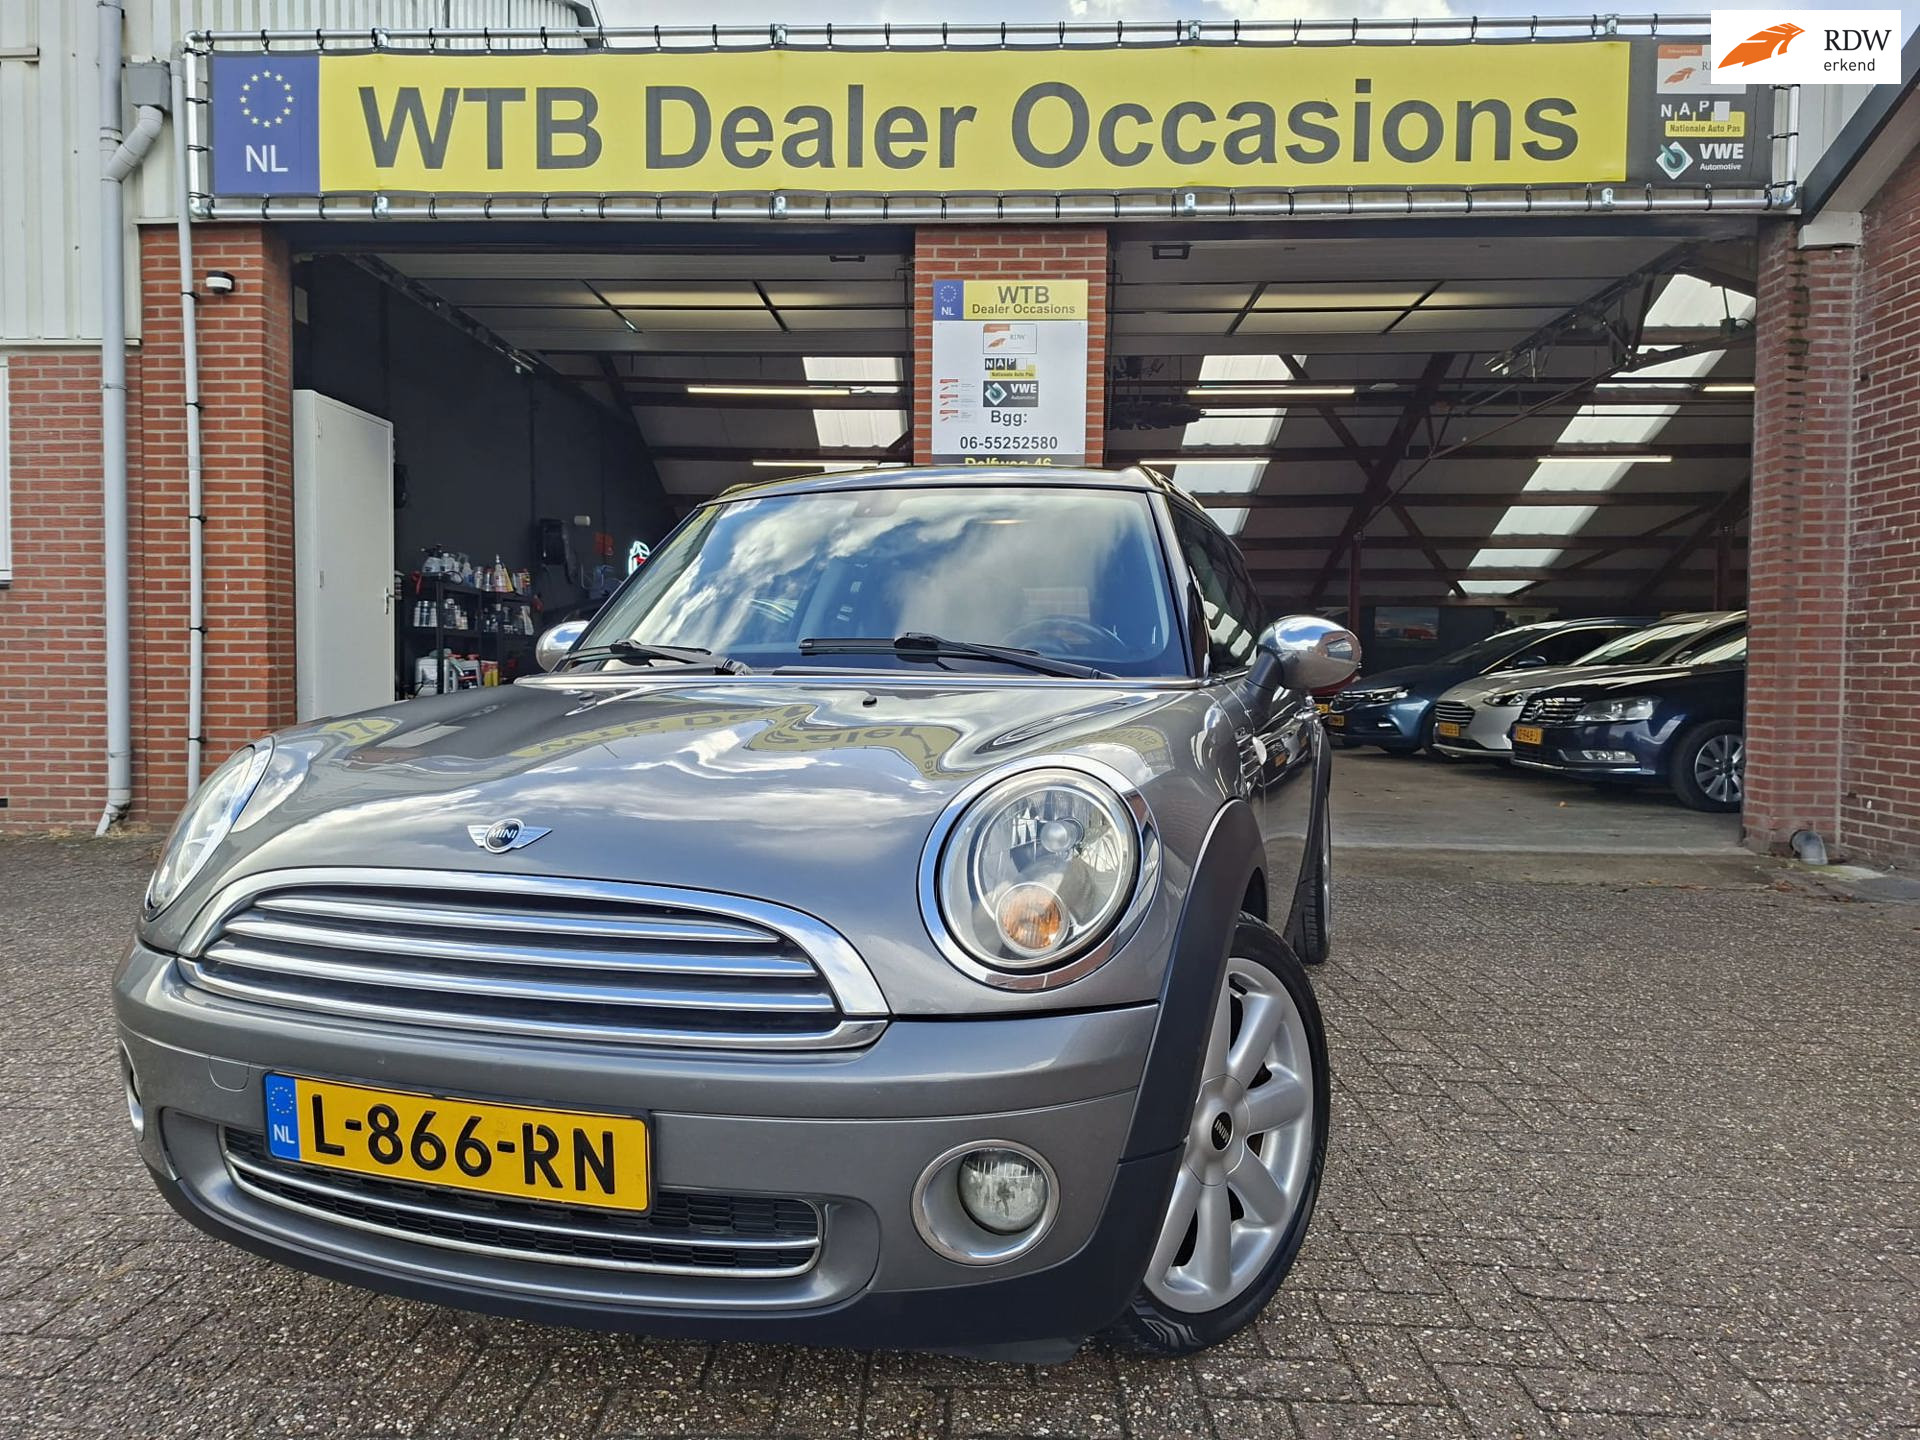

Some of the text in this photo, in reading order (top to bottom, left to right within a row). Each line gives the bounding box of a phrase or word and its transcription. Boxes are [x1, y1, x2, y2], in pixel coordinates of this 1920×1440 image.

[357, 78, 1580, 170] WTB Dealer Occasions
[1670, 123, 1741, 133] Nationale Auto Pas
[245, 144, 288, 173] NL
[1699, 143, 1744, 160] VWE
[1700, 162, 1742, 171] Automotive
[998, 286, 1050, 304] WTB
[941, 306, 955, 316] NL
[972, 303, 1076, 315] Dealer Occasions
[1010, 383, 1037, 394] VWE
[991, 410, 1028, 427] Bgg:
[960, 436, 1058, 449] 06-55252580
[488, 828, 518, 839] MINI
[273, 1124, 295, 1144] NL
[312, 1094, 616, 1195] L-866-RN
